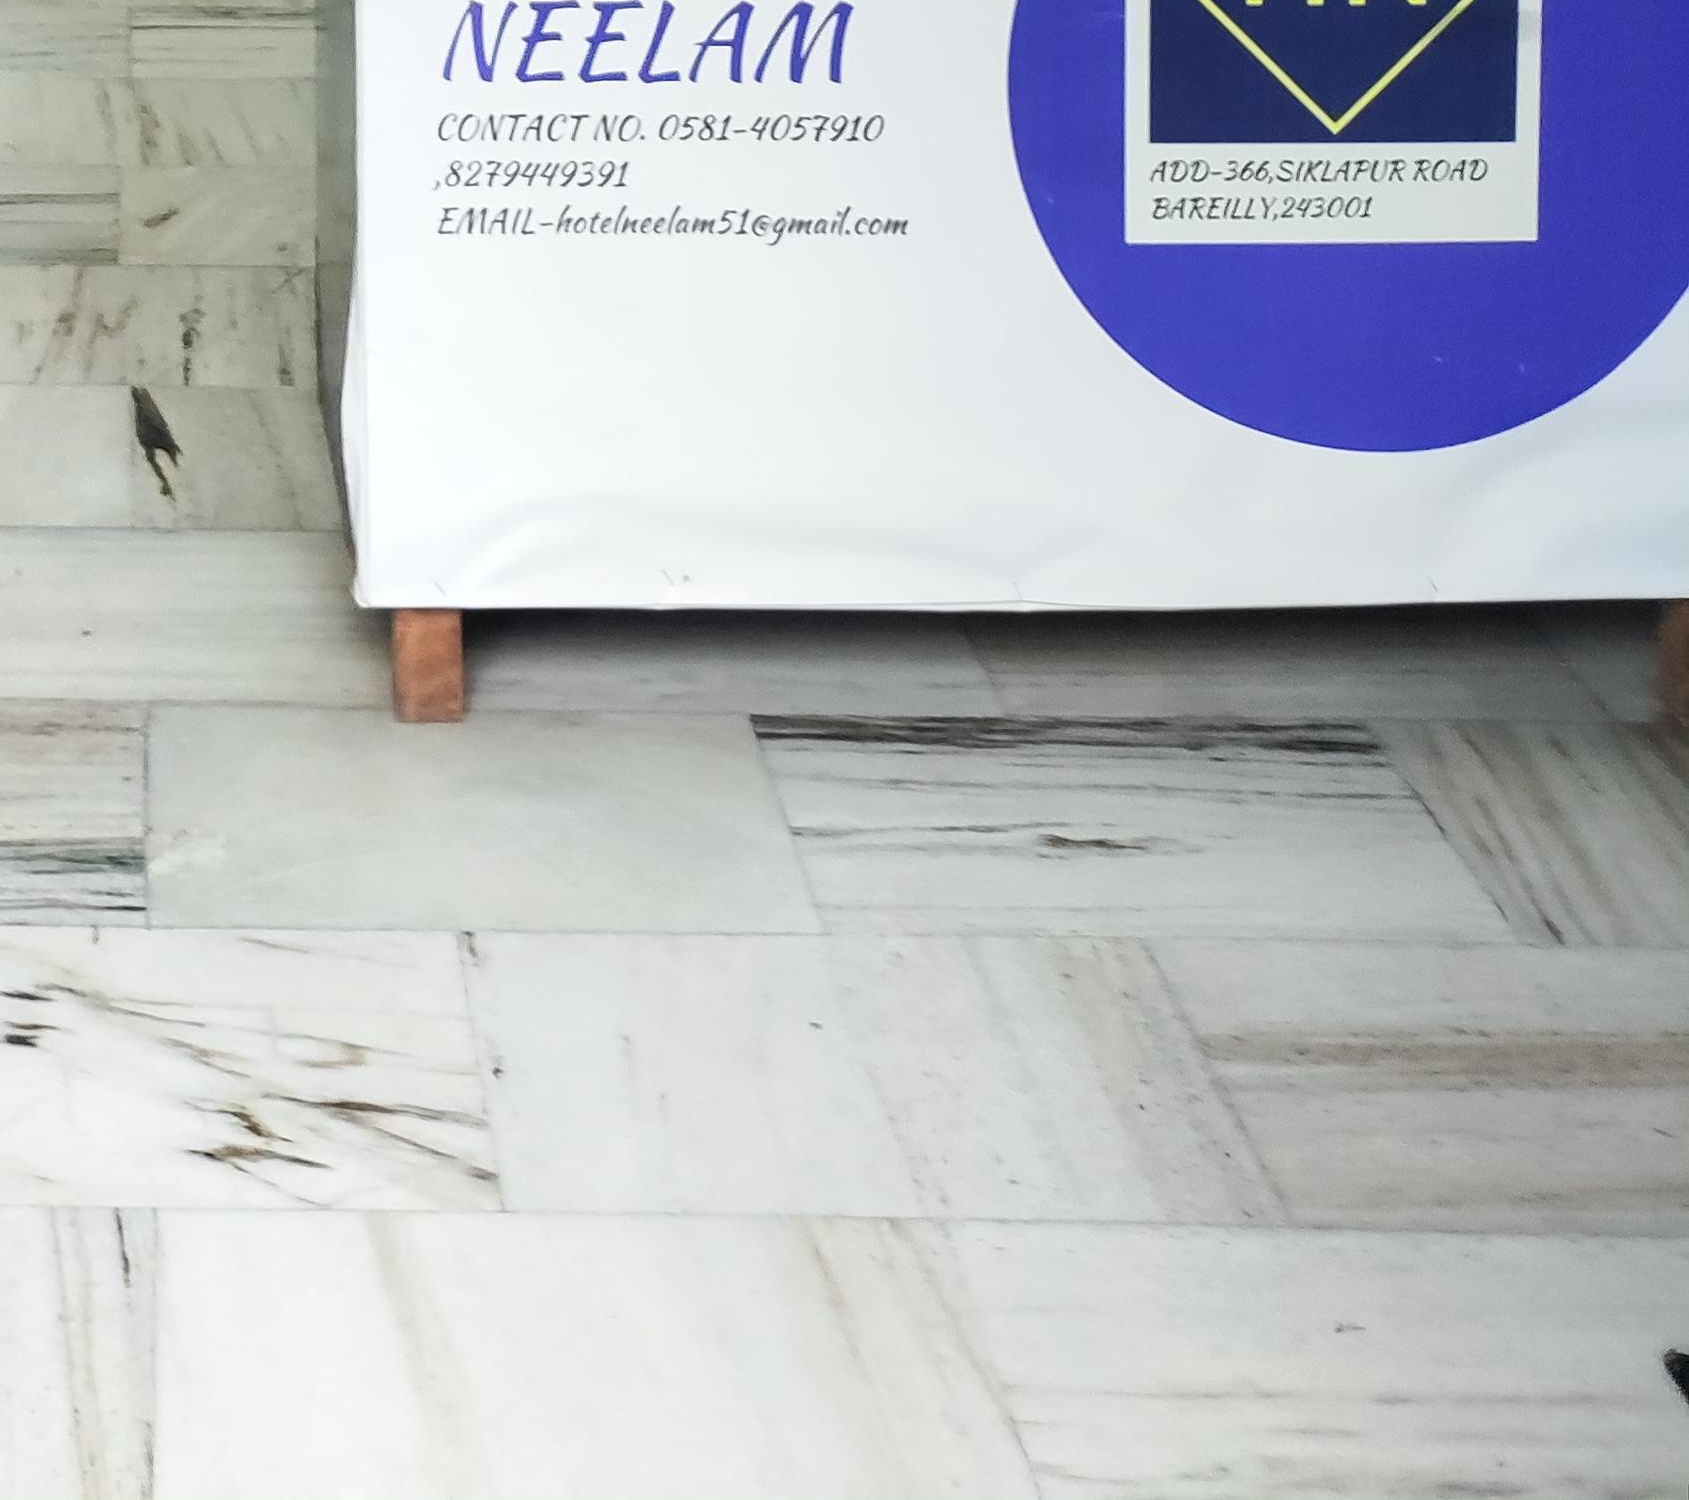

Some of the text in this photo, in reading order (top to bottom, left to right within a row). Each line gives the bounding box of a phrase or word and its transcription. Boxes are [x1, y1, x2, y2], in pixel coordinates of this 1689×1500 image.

[444, 1, 855, 84] NEELAM
[438, 114, 884, 142] CONTACT NO. 0581-4057910
[433, 160, 629, 190] ,8279449391
[1150, 159, 1488, 184] ADD-366,SIKLAPUR ROAD
[1152, 196, 1373, 222] BAREILLY,243001
[438, 204, 910, 246] EMAIL-hotelneelam51@gmail.com
